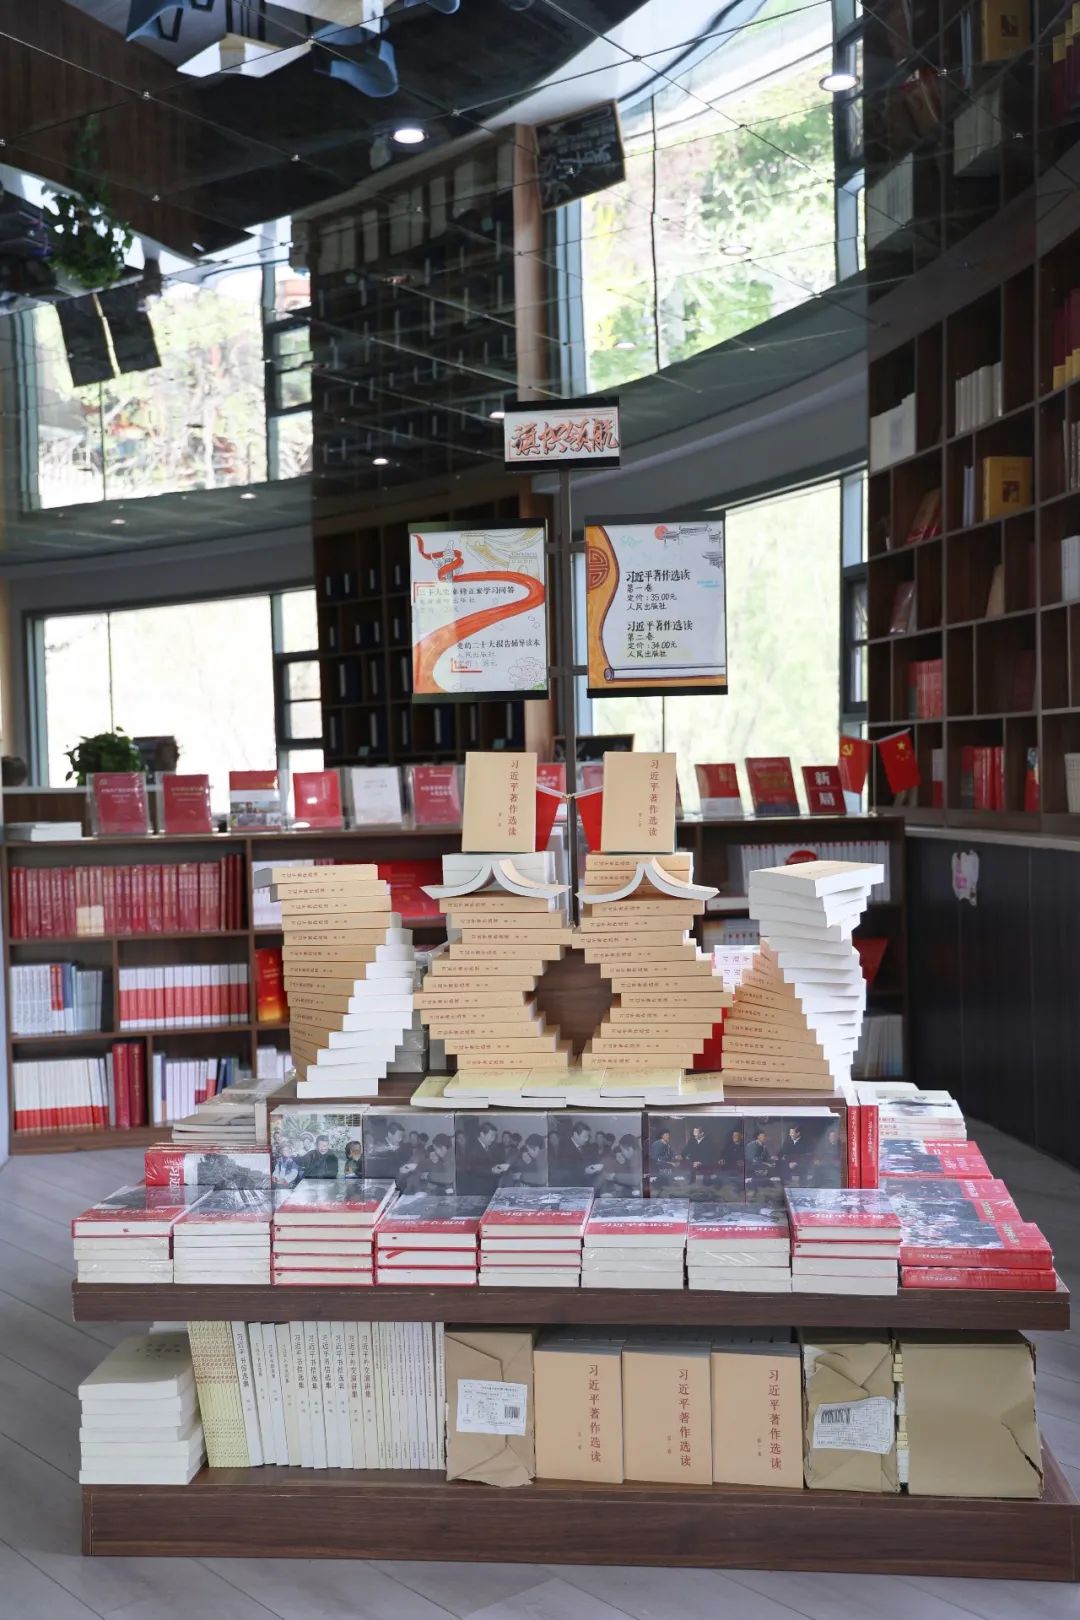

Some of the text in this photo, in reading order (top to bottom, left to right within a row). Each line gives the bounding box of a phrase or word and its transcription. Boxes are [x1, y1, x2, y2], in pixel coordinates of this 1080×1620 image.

[626, 569, 691, 583] 习近平著作选读
[627, 584, 652, 593] 第一卷
[627, 603, 667, 611] 人民出版社
[627, 620, 693, 632] 习近平著作选读
[627, 633, 655, 642] 第二卷
[627, 650, 667, 658] 人民出版社
[508, 760, 519, 836] 习近平著作选读
[648, 760, 659, 837] 习近平著作选读
[588, 1364, 601, 1463] 习近平著作选读
[678, 1368, 691, 1467] 习近平著作选读
[768, 1369, 781, 1470] 习近平著作选读
